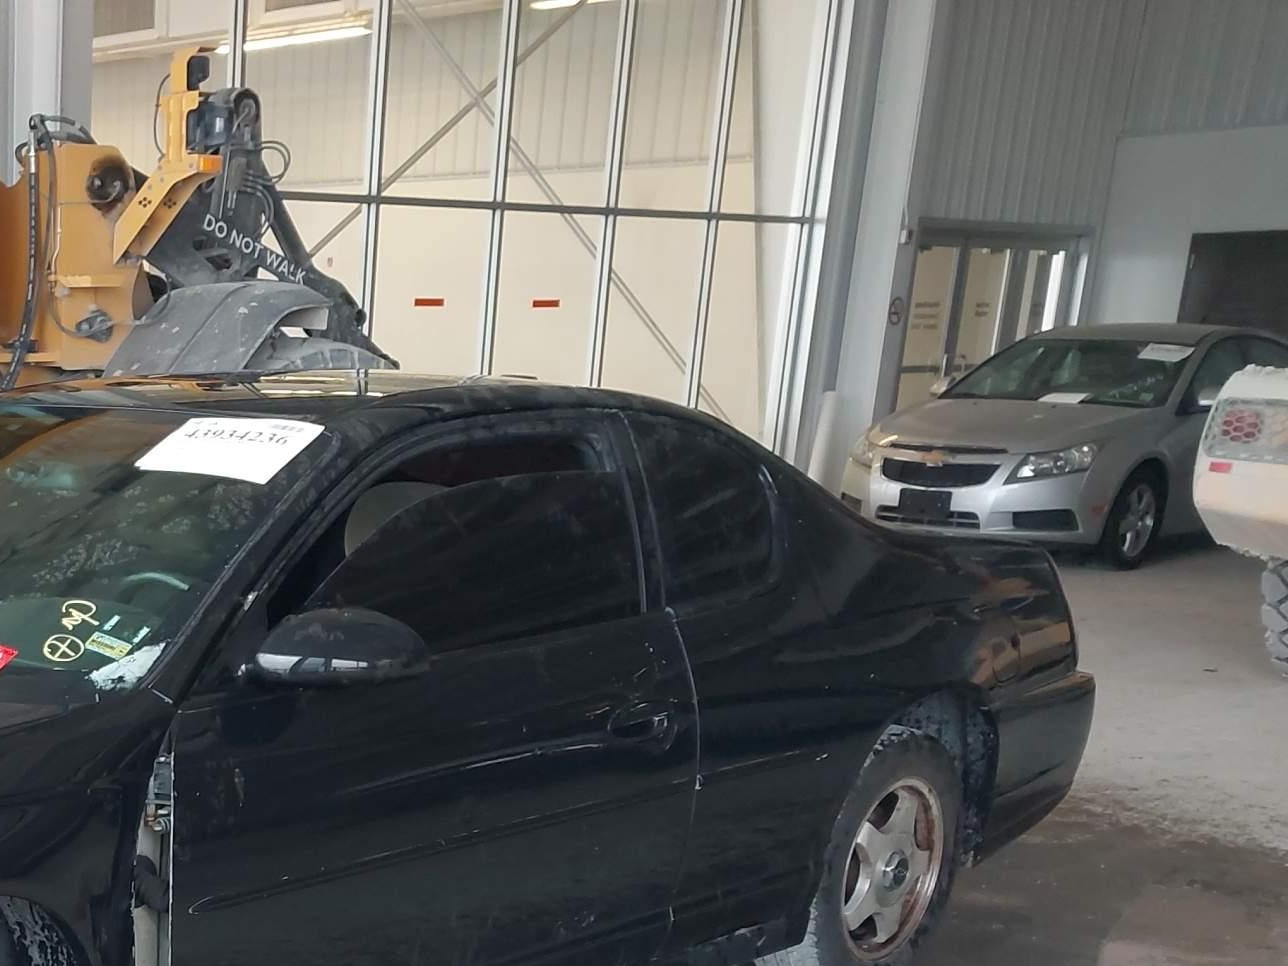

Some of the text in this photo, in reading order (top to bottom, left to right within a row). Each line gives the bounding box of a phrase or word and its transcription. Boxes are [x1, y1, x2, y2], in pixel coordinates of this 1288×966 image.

[203, 213, 306, 286] DO NOT WALK
